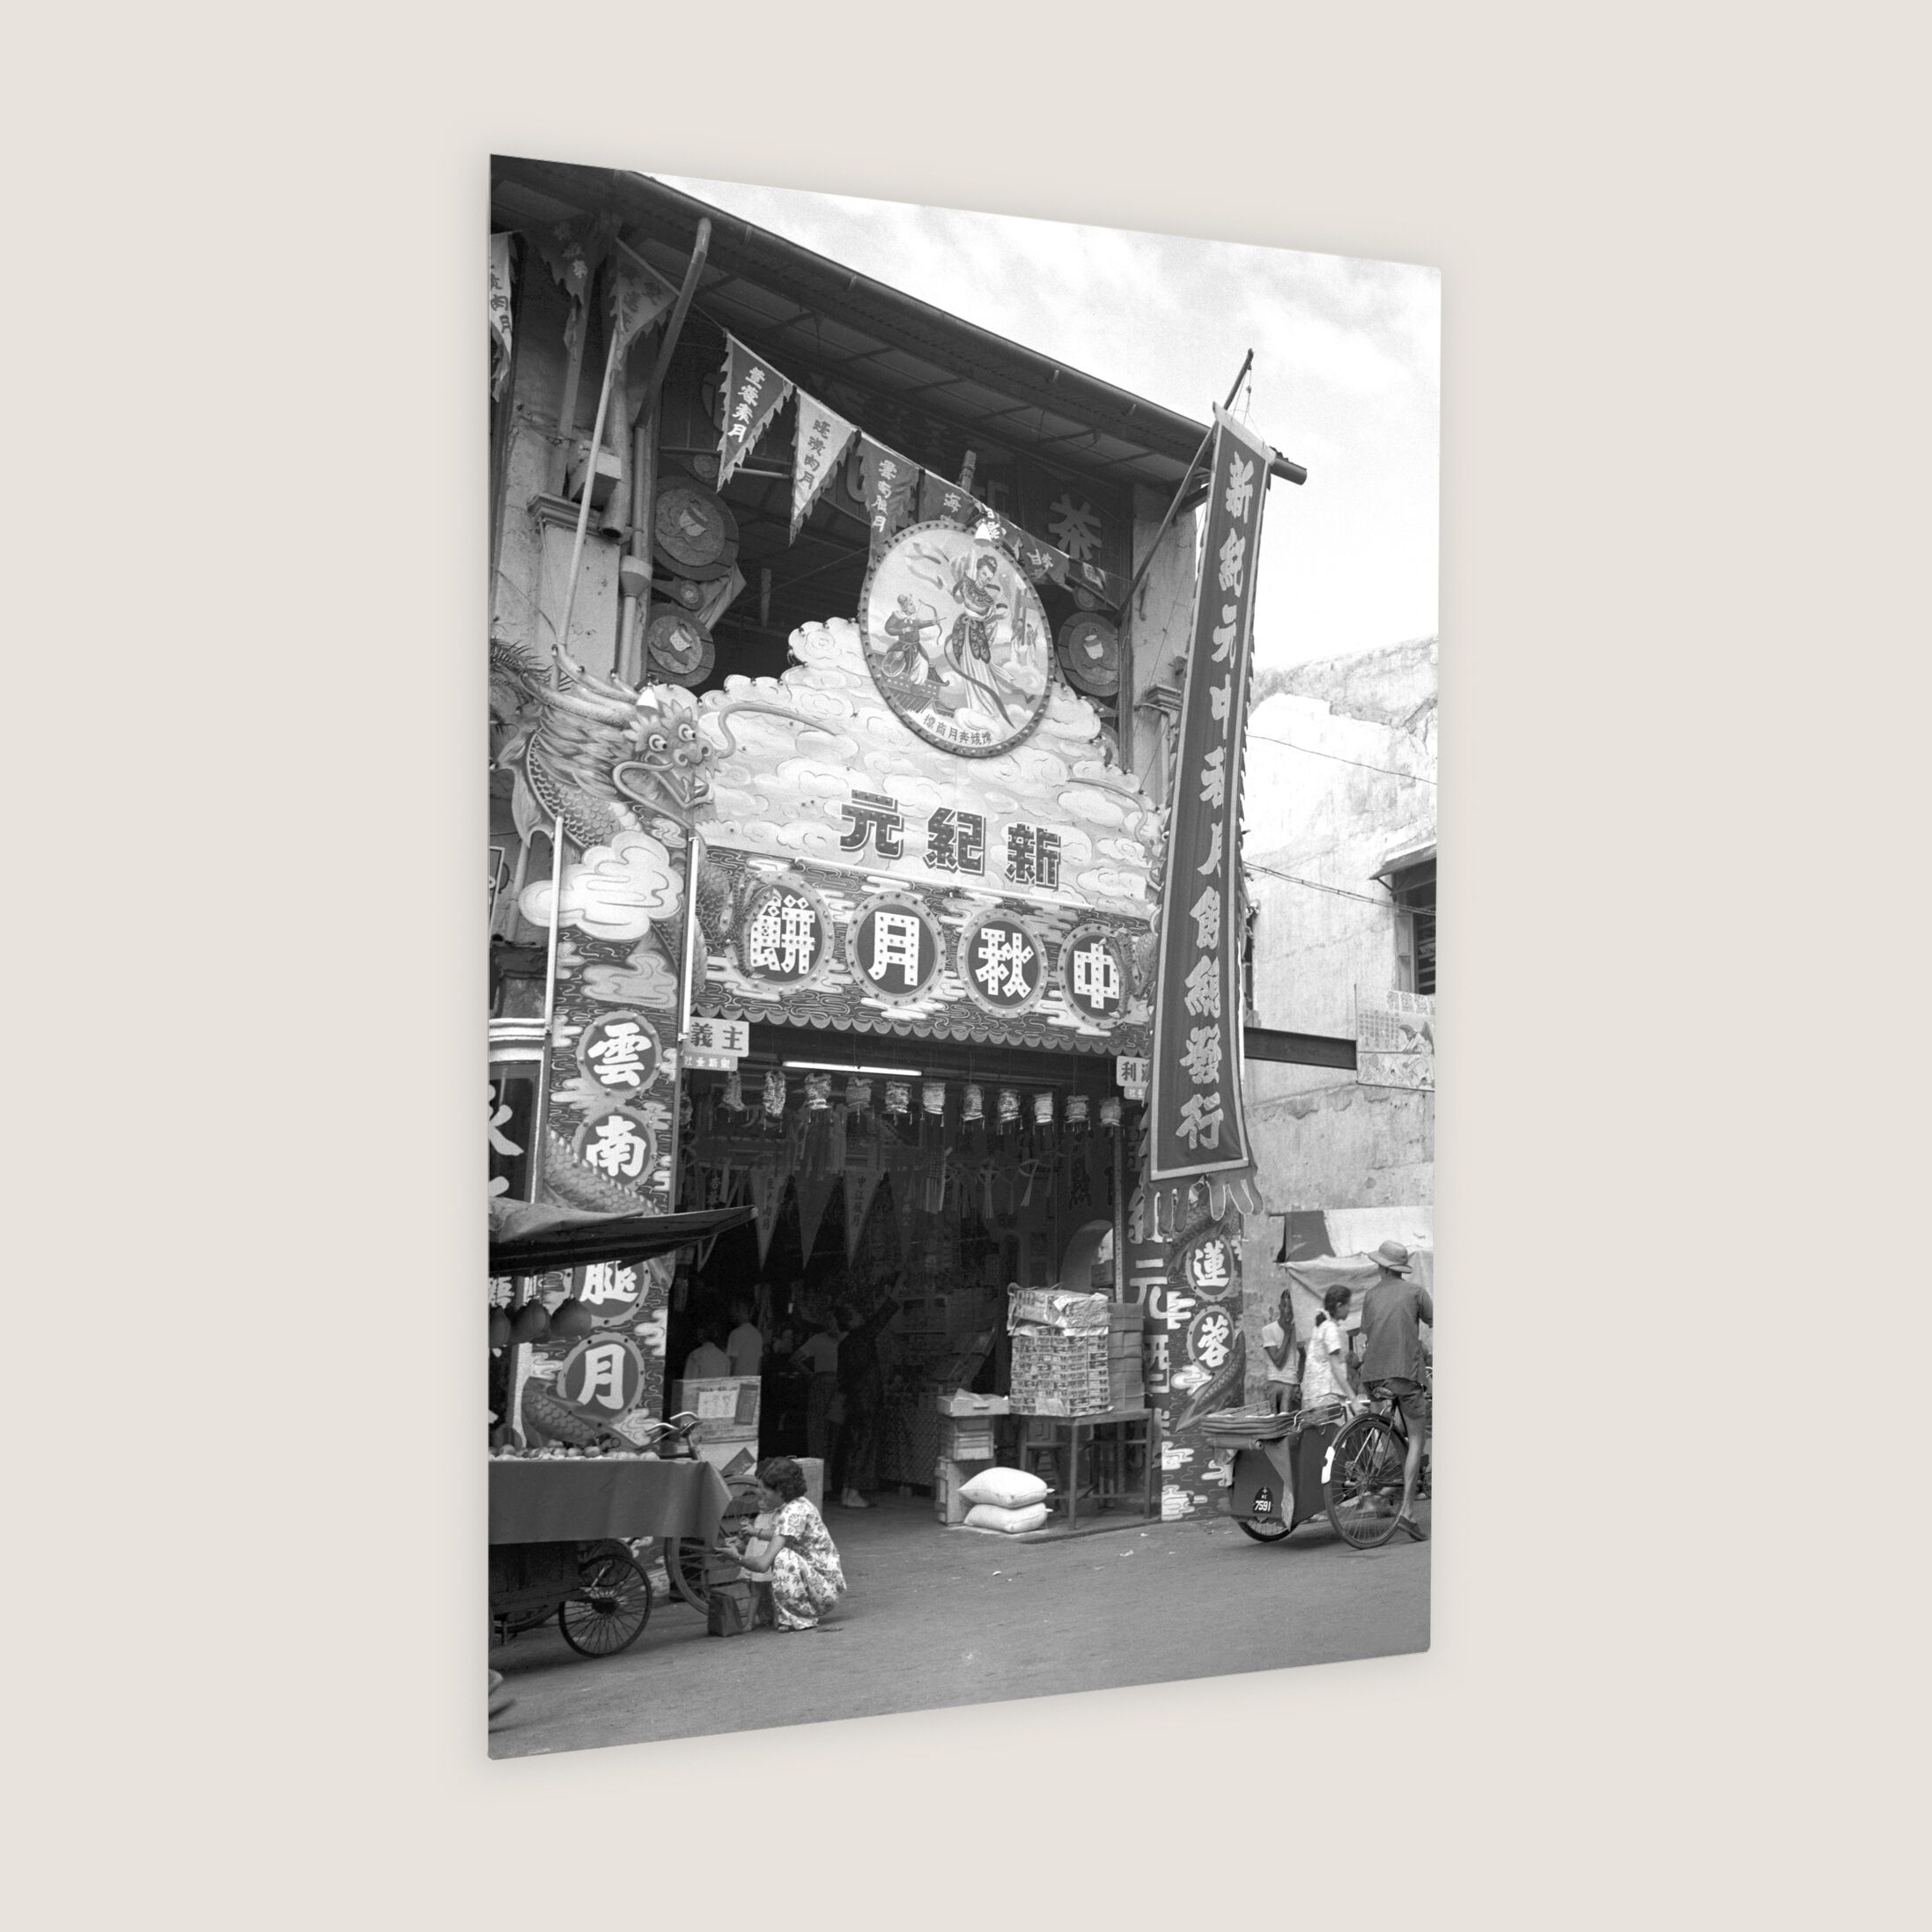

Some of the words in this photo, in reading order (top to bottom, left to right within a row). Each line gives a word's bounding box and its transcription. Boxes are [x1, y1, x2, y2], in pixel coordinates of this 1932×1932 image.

[840, 789, 1061, 890] 新紀元
[749, 894, 1121, 1009] 中秋月餅
[1191, 1239, 1230, 1368] 蓮蓉
[1254, 1500, 1272, 1512] 7591
